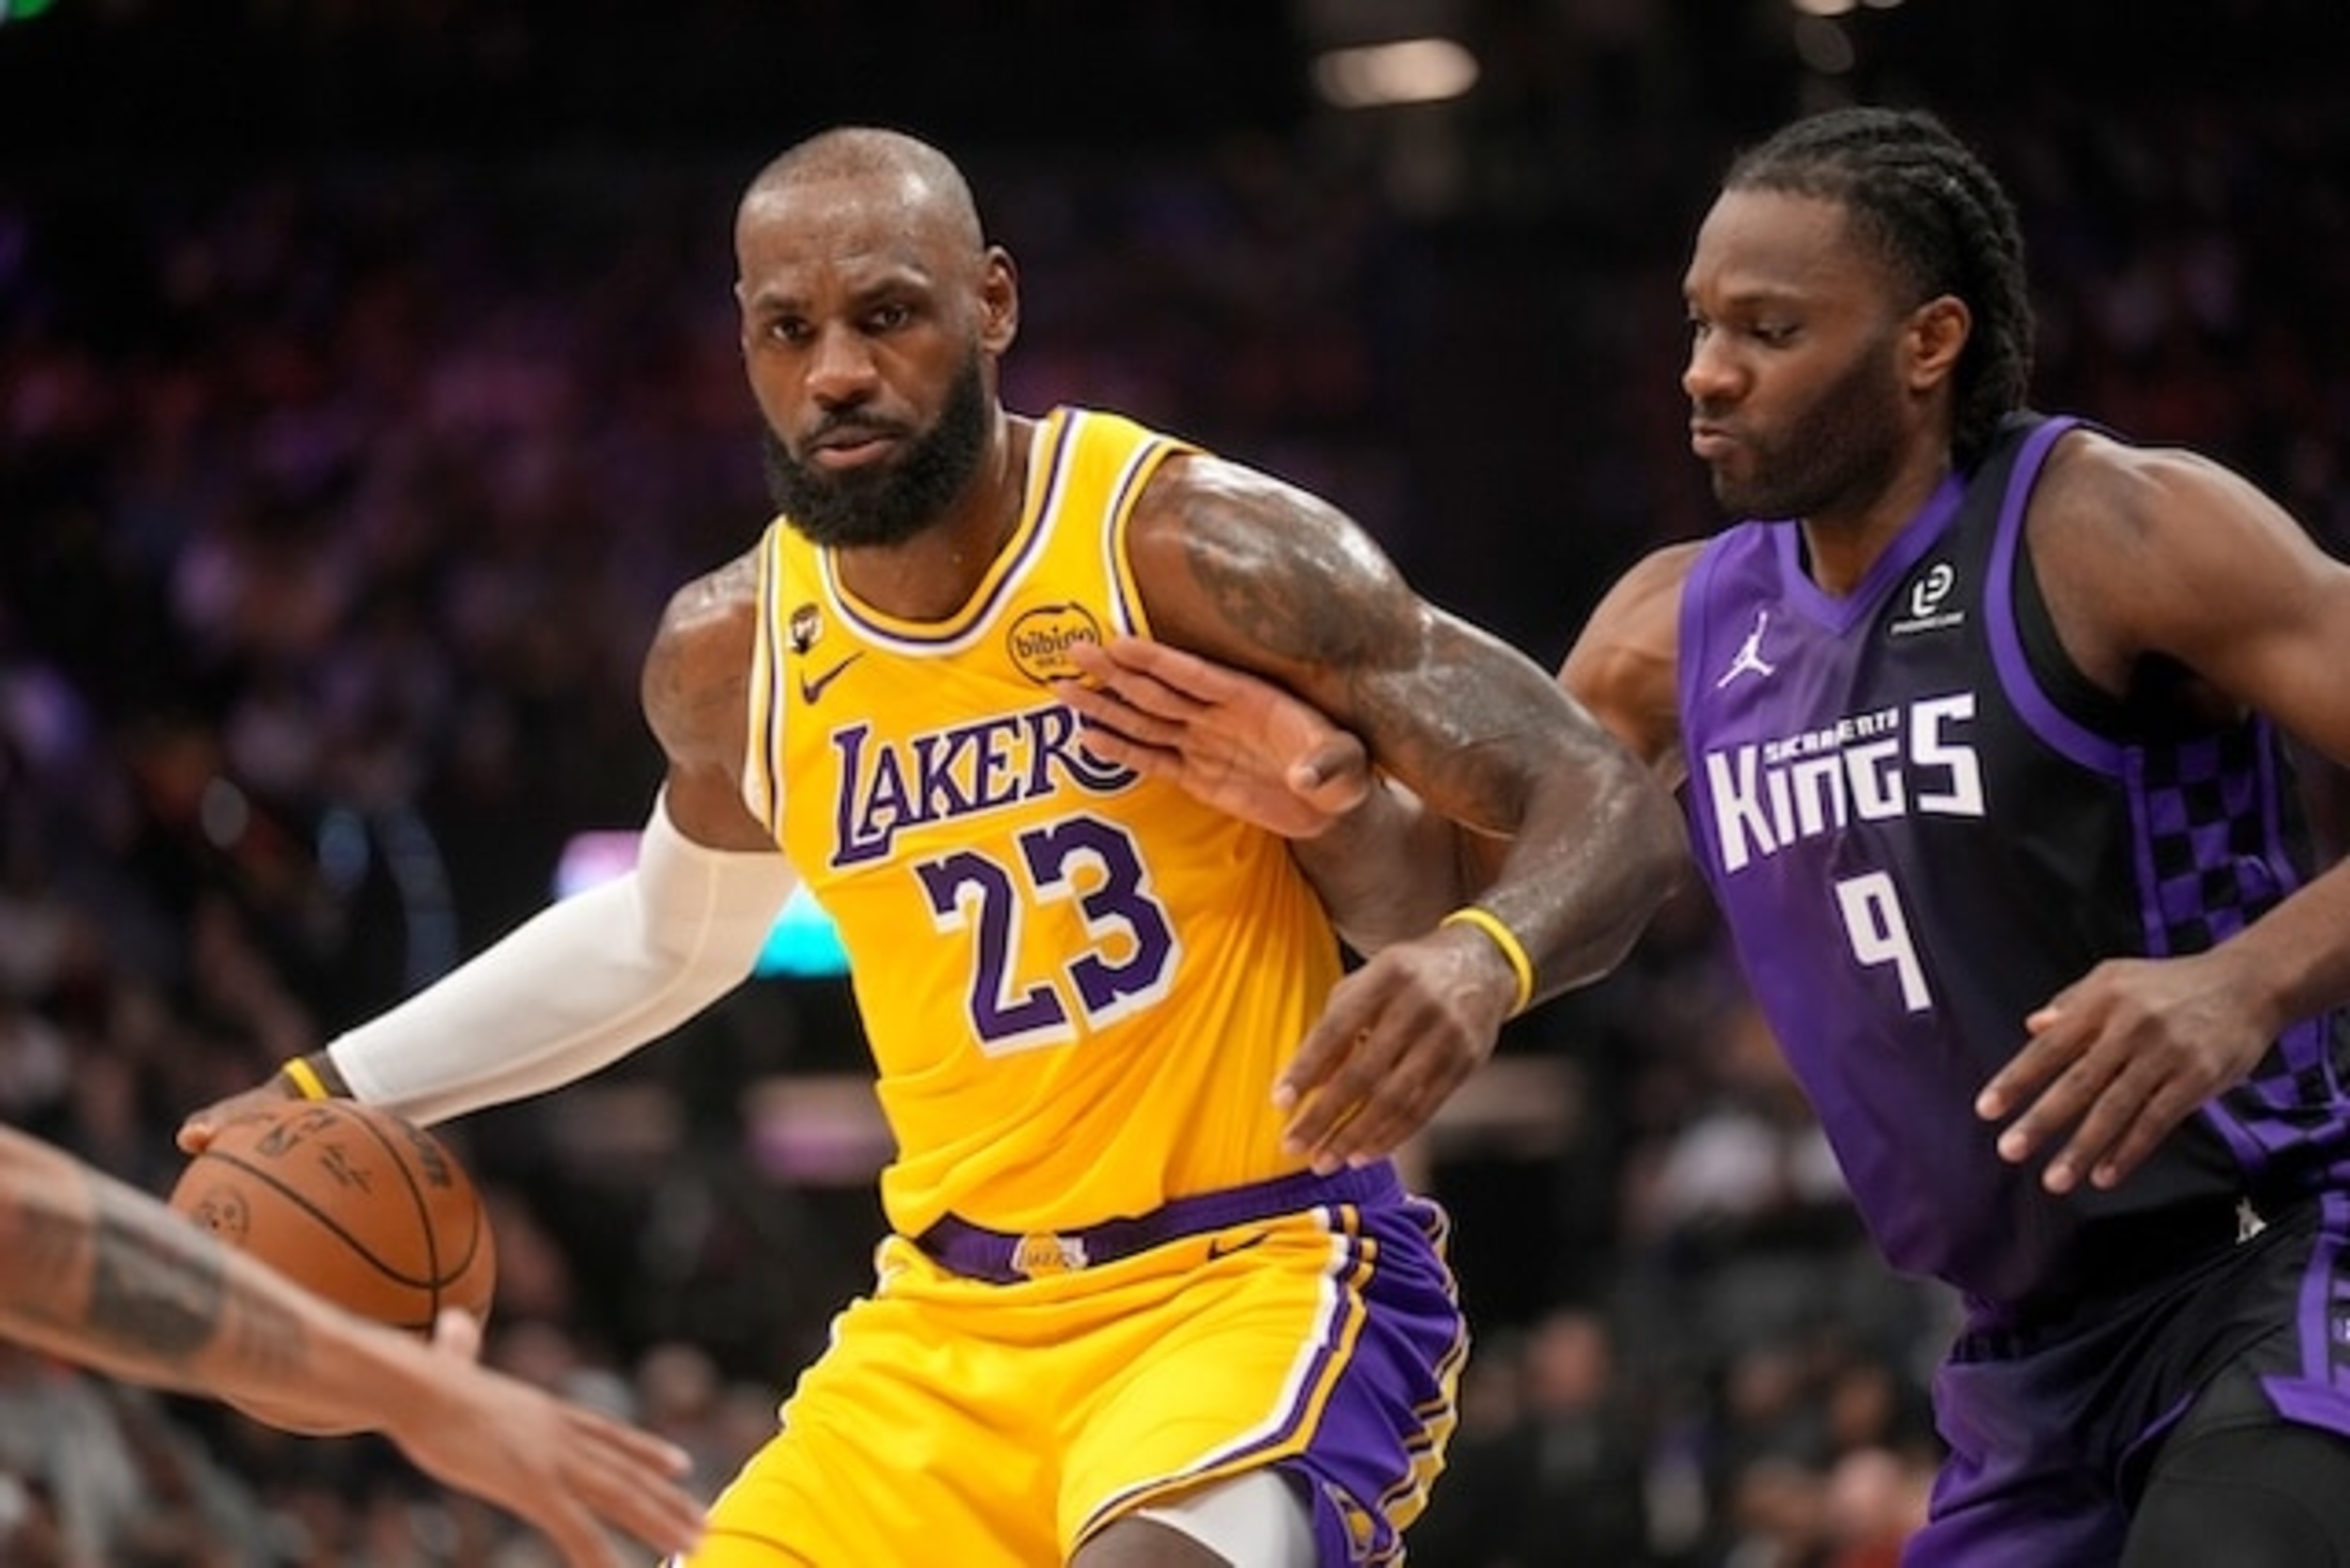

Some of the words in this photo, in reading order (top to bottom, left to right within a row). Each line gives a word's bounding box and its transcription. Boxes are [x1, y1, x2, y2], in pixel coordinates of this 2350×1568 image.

[831, 703, 1140, 868] LAKER
[912, 815, 1177, 1045] 23
[1835, 870, 1933, 1012] 9
